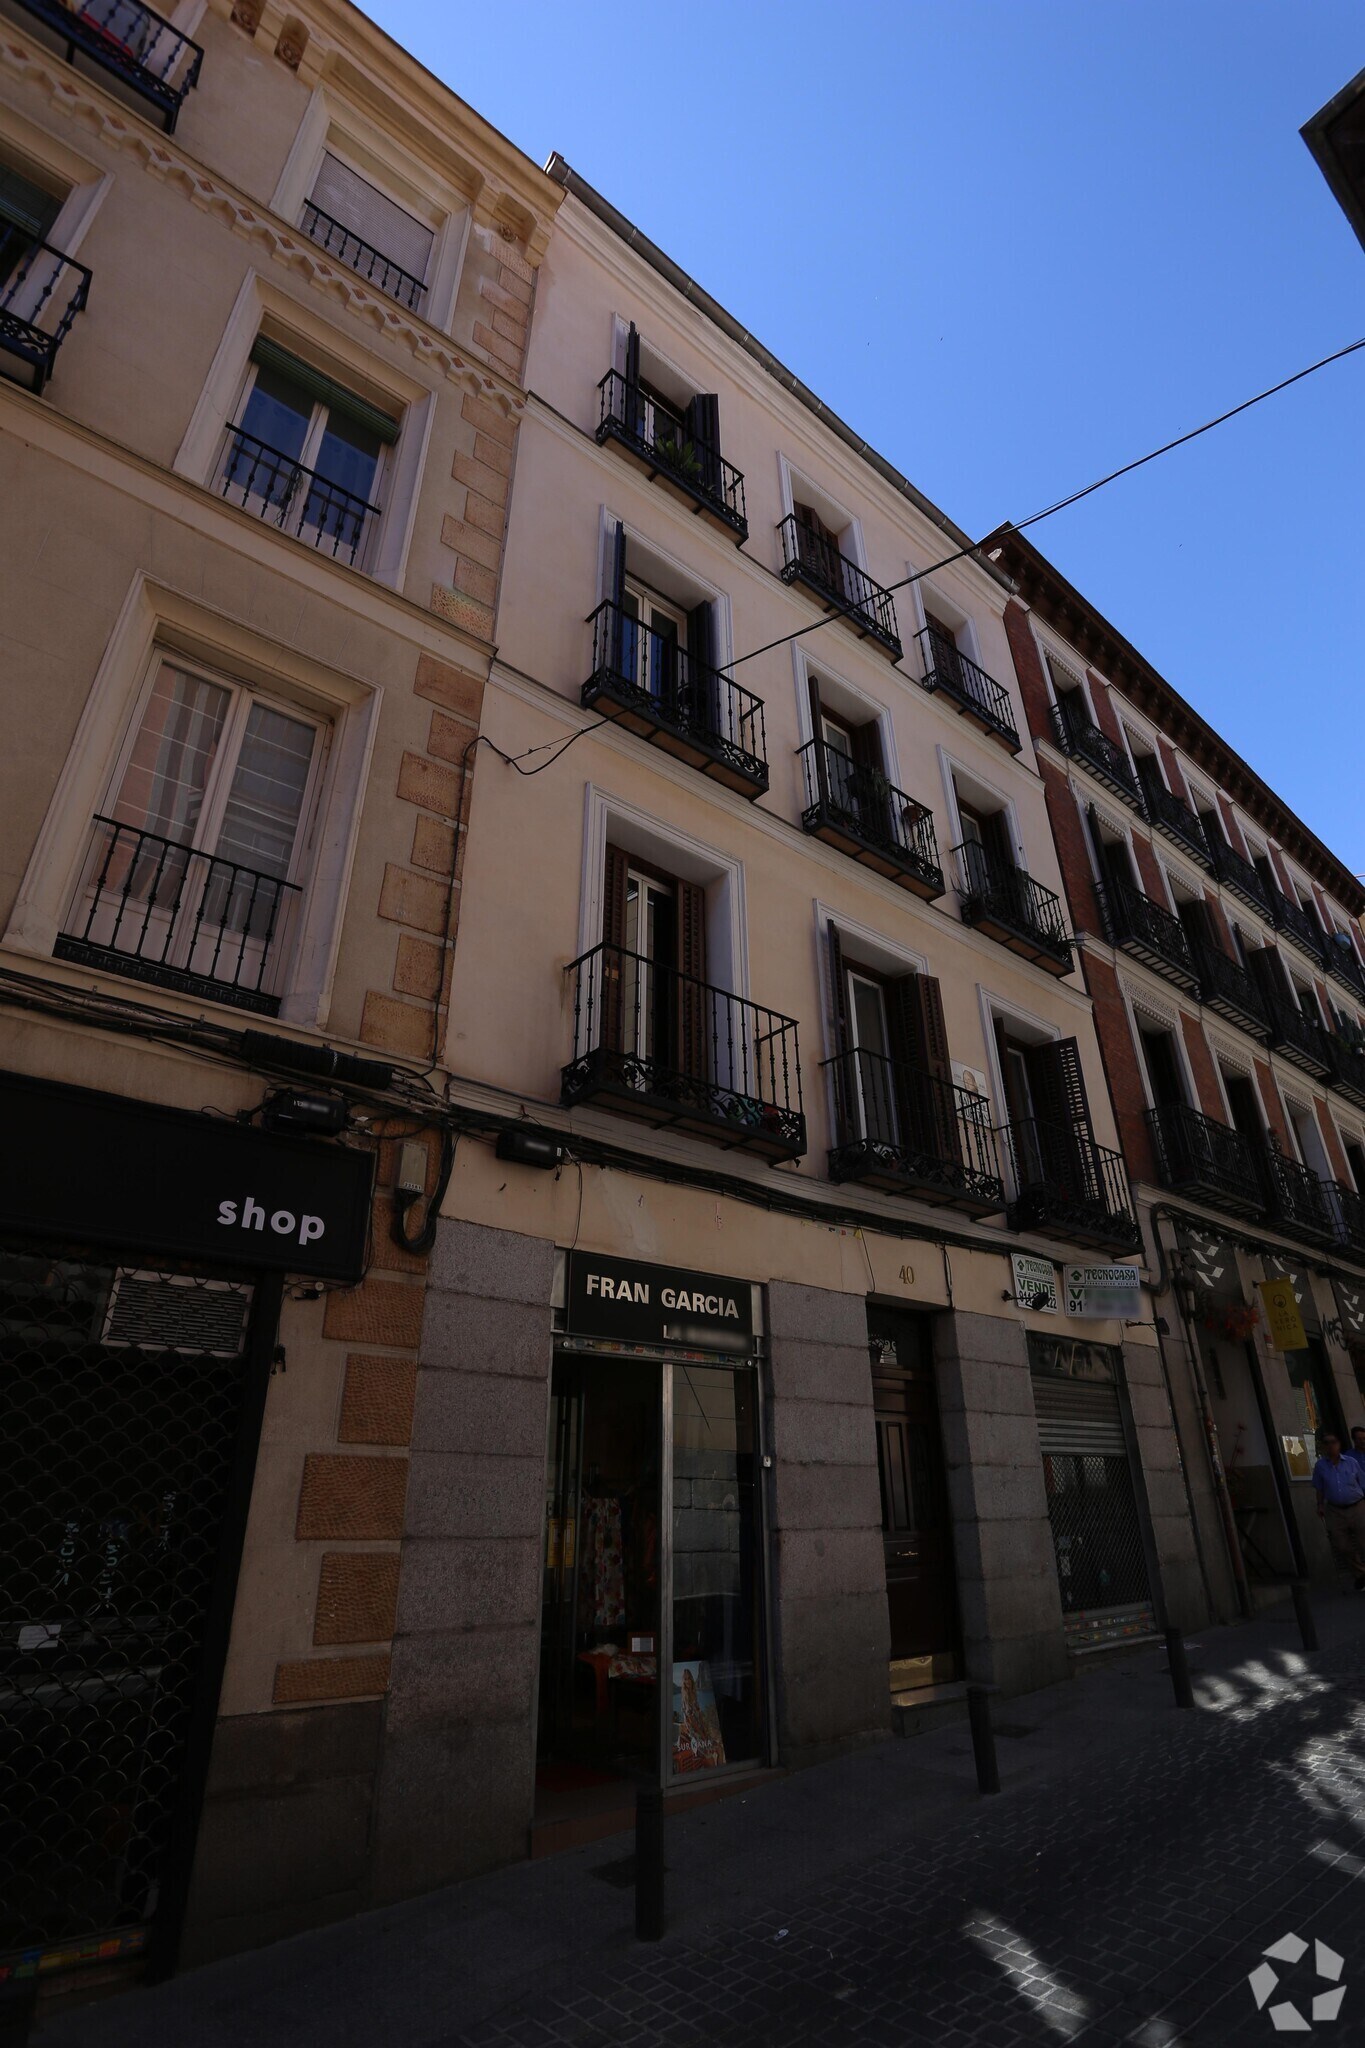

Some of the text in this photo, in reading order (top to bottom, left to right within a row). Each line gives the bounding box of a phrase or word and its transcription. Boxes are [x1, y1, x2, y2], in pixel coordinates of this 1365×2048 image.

[216, 1196, 325, 1246] shop
[898, 1264, 915, 1285] 40
[1085, 1269, 1136, 1281] TECNOCASA
[586, 1273, 740, 1320] FRAN GARCIA
[1017, 1278, 1056, 1297] VENDE
